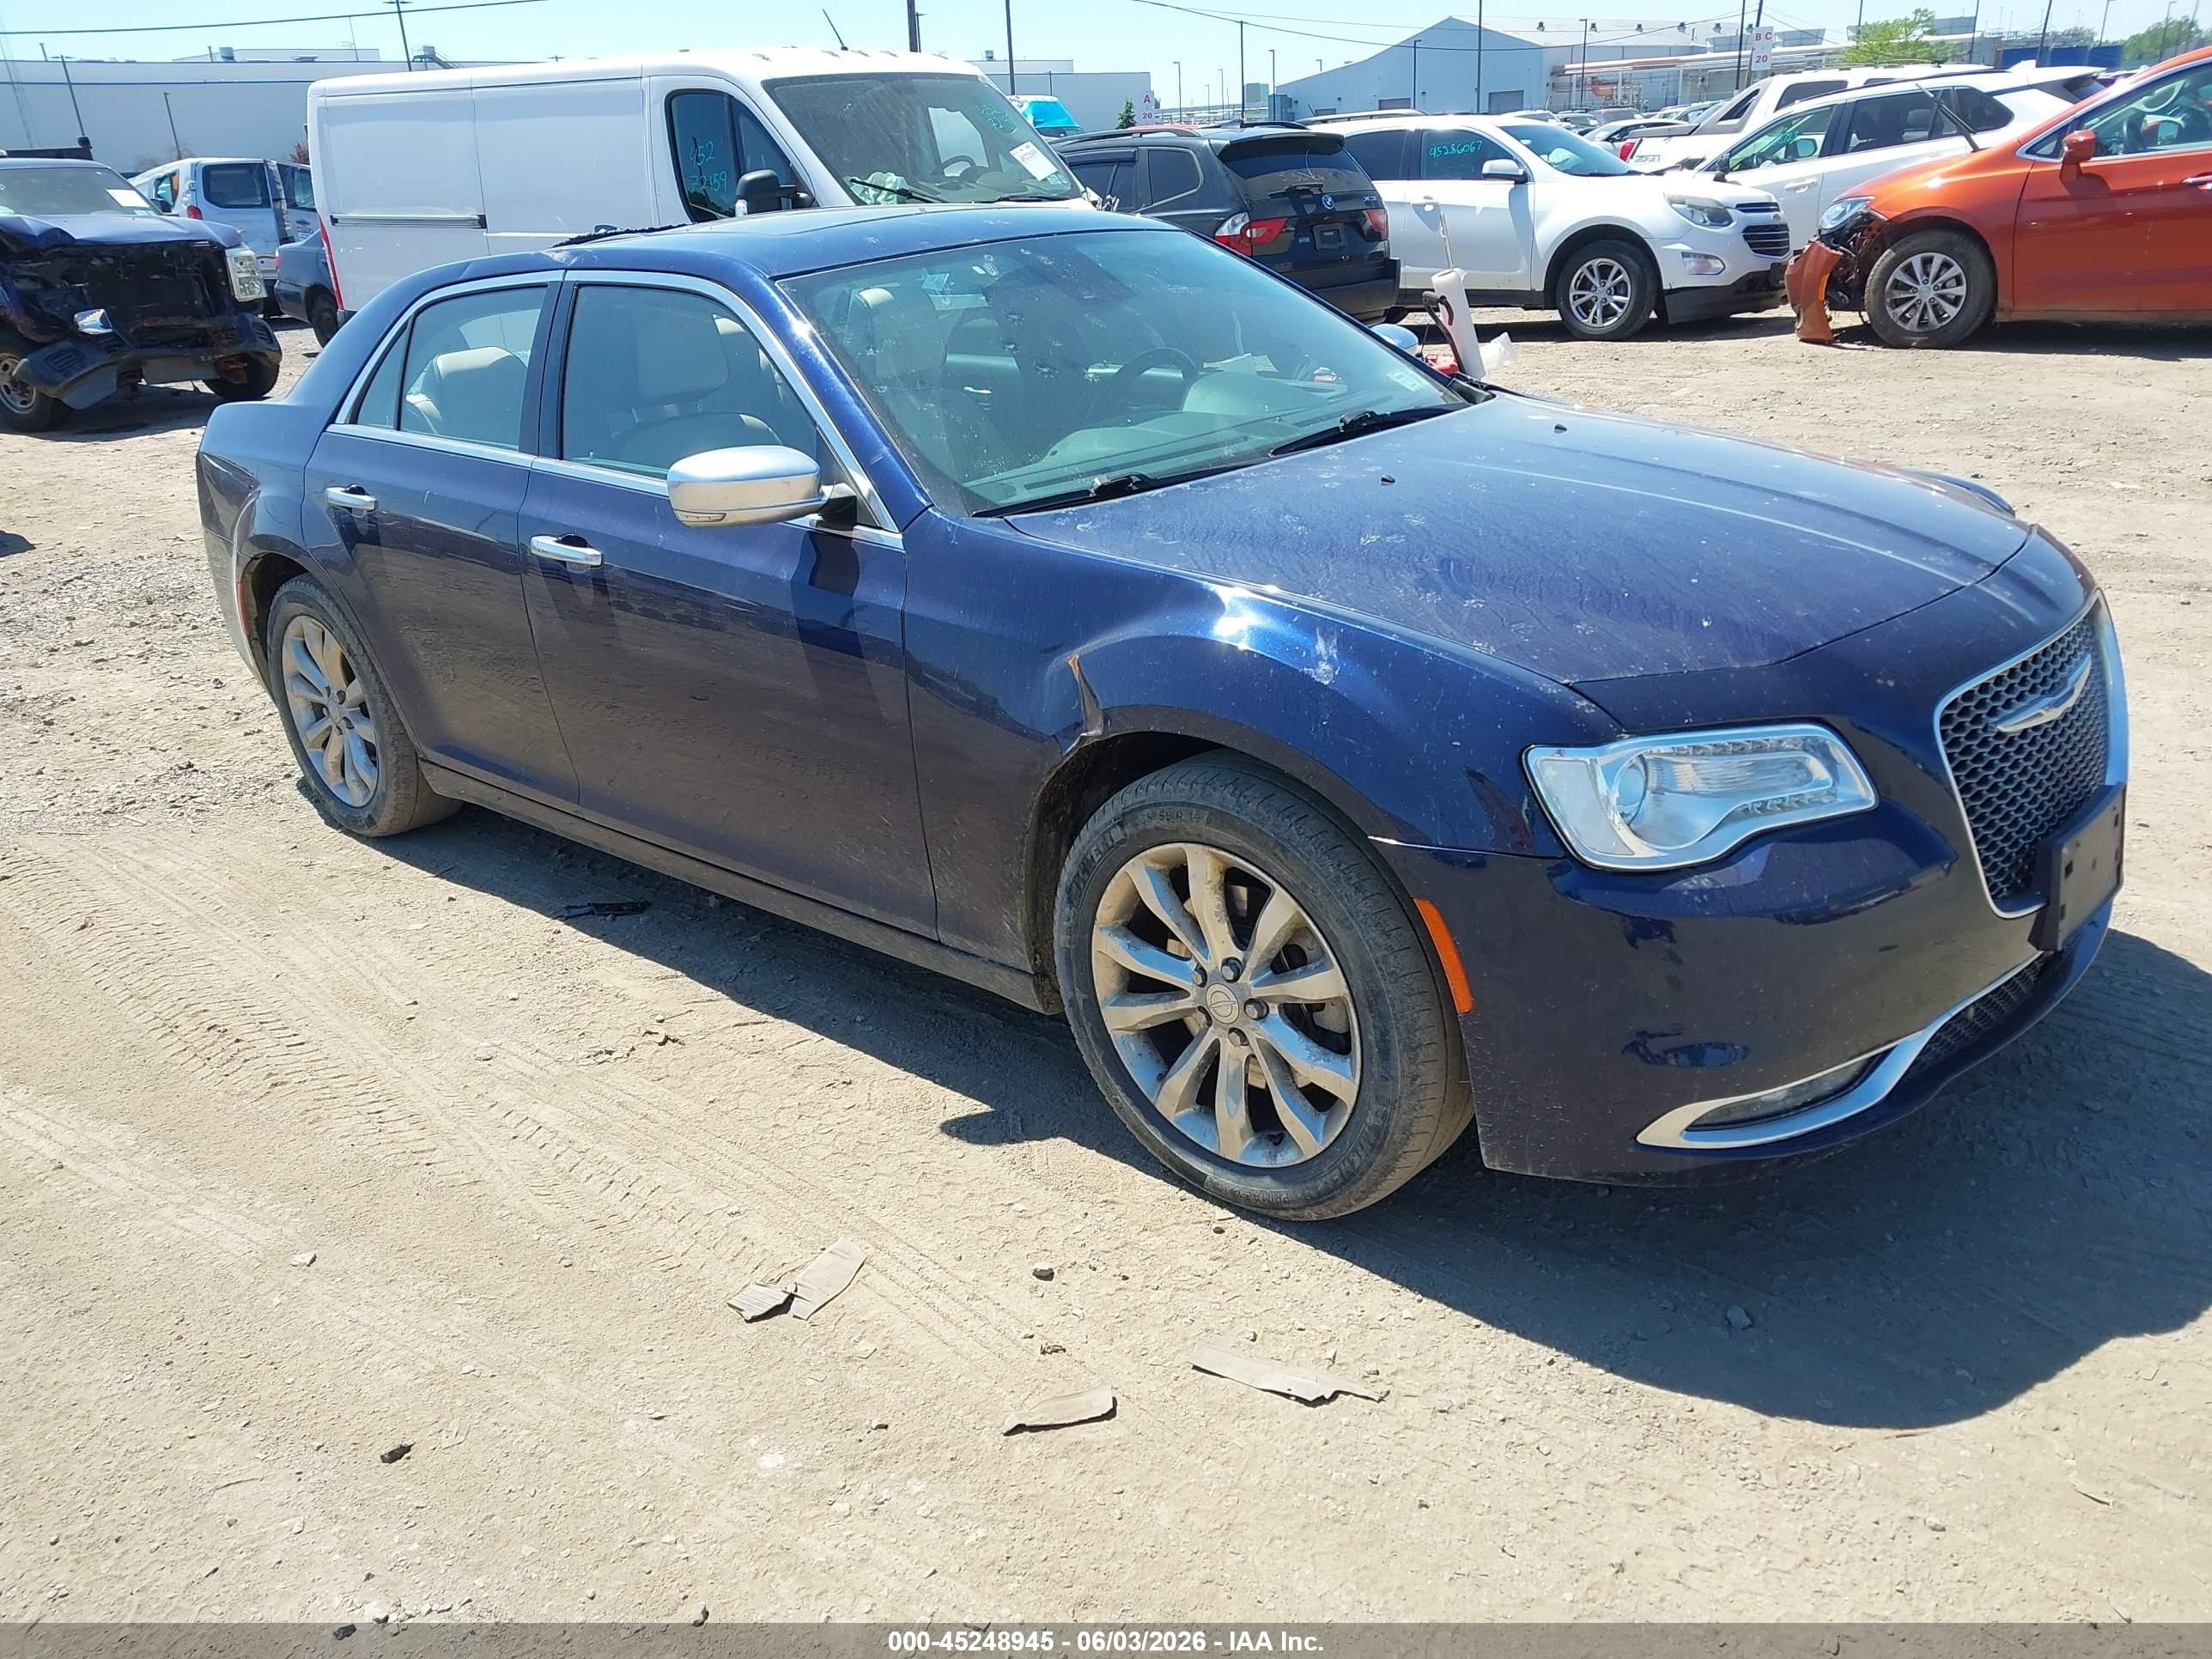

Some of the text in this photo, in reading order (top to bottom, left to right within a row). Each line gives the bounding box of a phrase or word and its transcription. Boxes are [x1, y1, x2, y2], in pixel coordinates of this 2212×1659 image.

[1755, 32, 1772, 41] B C
[1755, 54, 1768, 64] 20
[1143, 94, 1152, 104] A
[1429, 140, 1483, 158] 45286067
